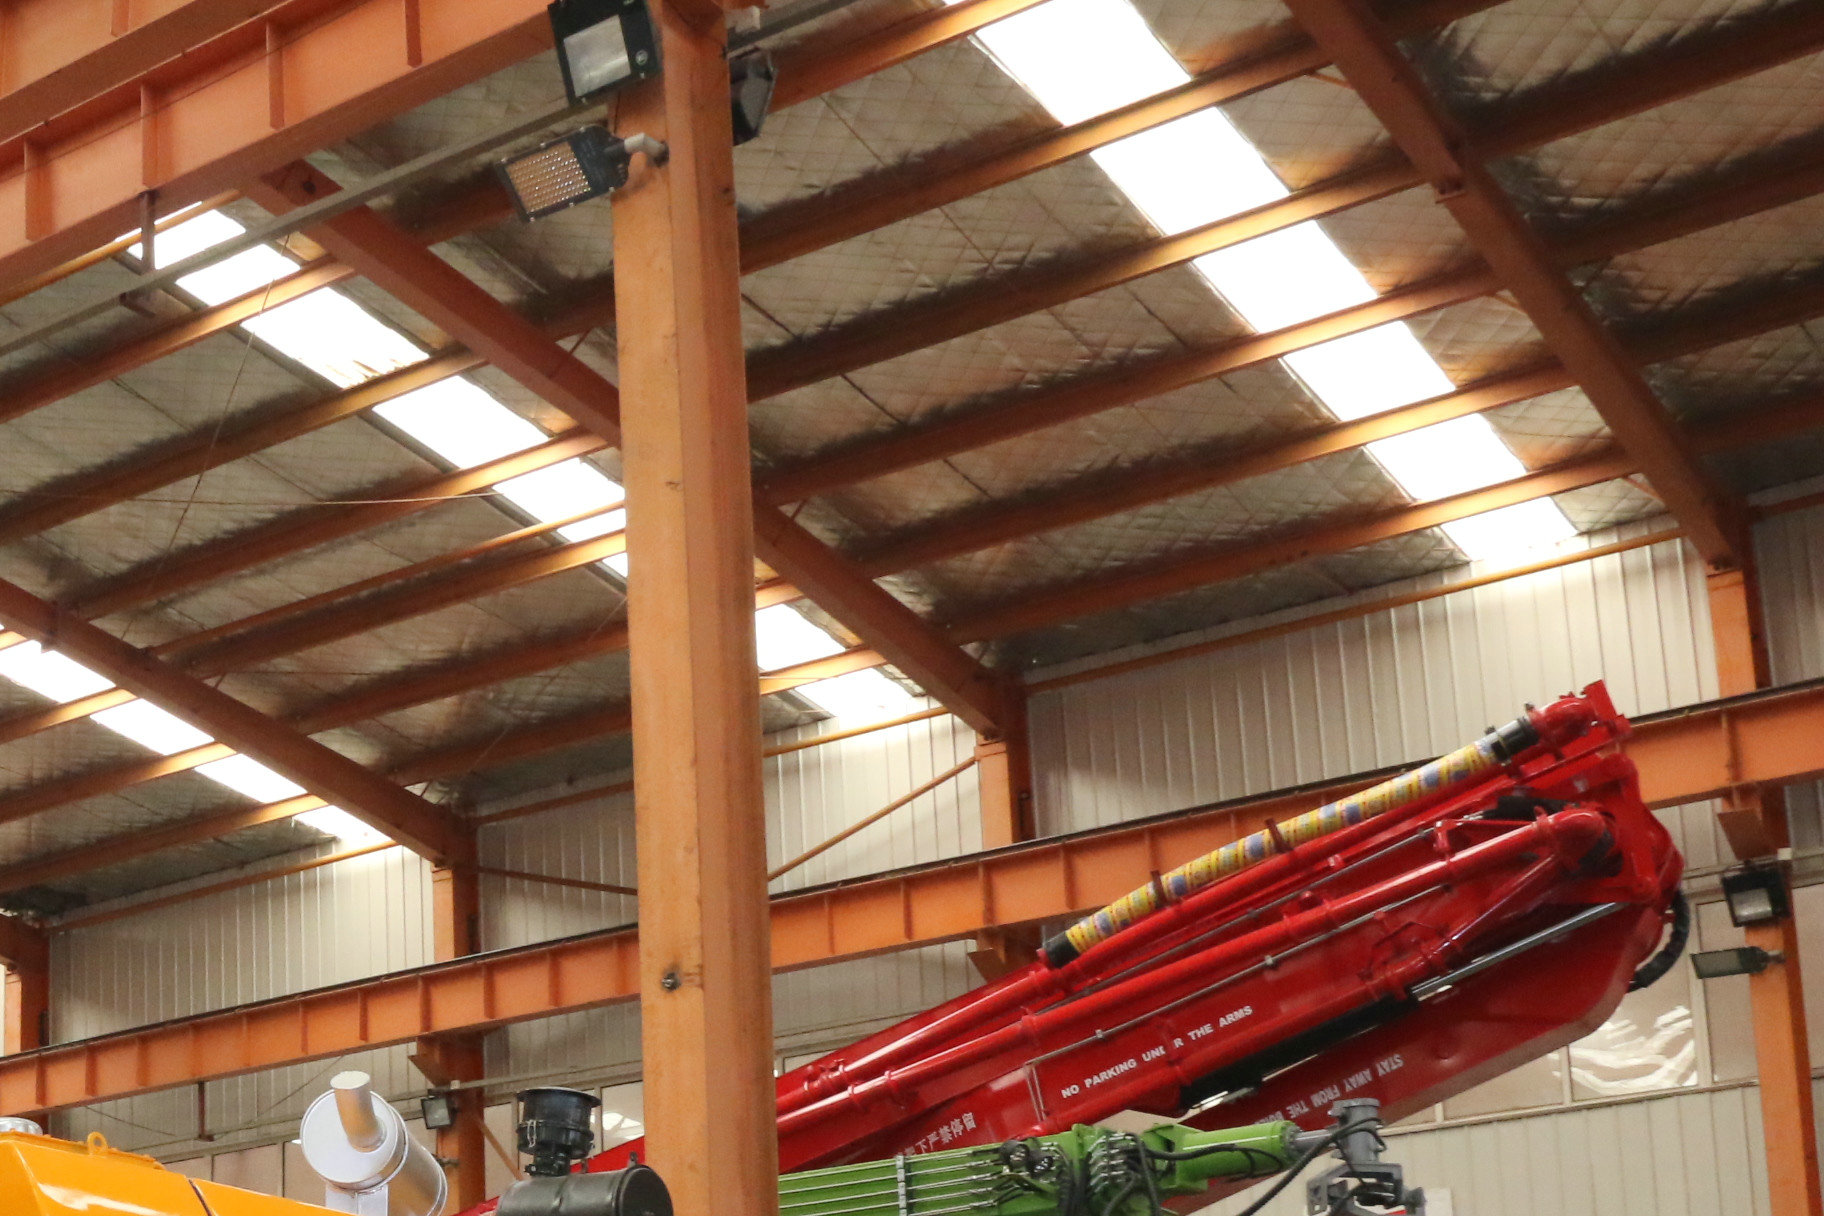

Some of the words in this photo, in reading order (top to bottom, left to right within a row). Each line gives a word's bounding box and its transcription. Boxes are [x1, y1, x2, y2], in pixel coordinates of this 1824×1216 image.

[1061, 1084, 1080, 1099] NO
[1084, 1058, 1138, 1088] PARKING
[1141, 1037, 1184, 1062] UNR
[1187, 1023, 1214, 1041] THE
[1218, 1005, 1254, 1028] ARMS
[1376, 1053, 1404, 1077] STAY
[1343, 1068, 1373, 1093] AWAY
[1310, 1084, 1341, 1108] FROM
[1286, 1100, 1310, 1119] THE
[898, 1111, 977, 1157] 下严禁停留
